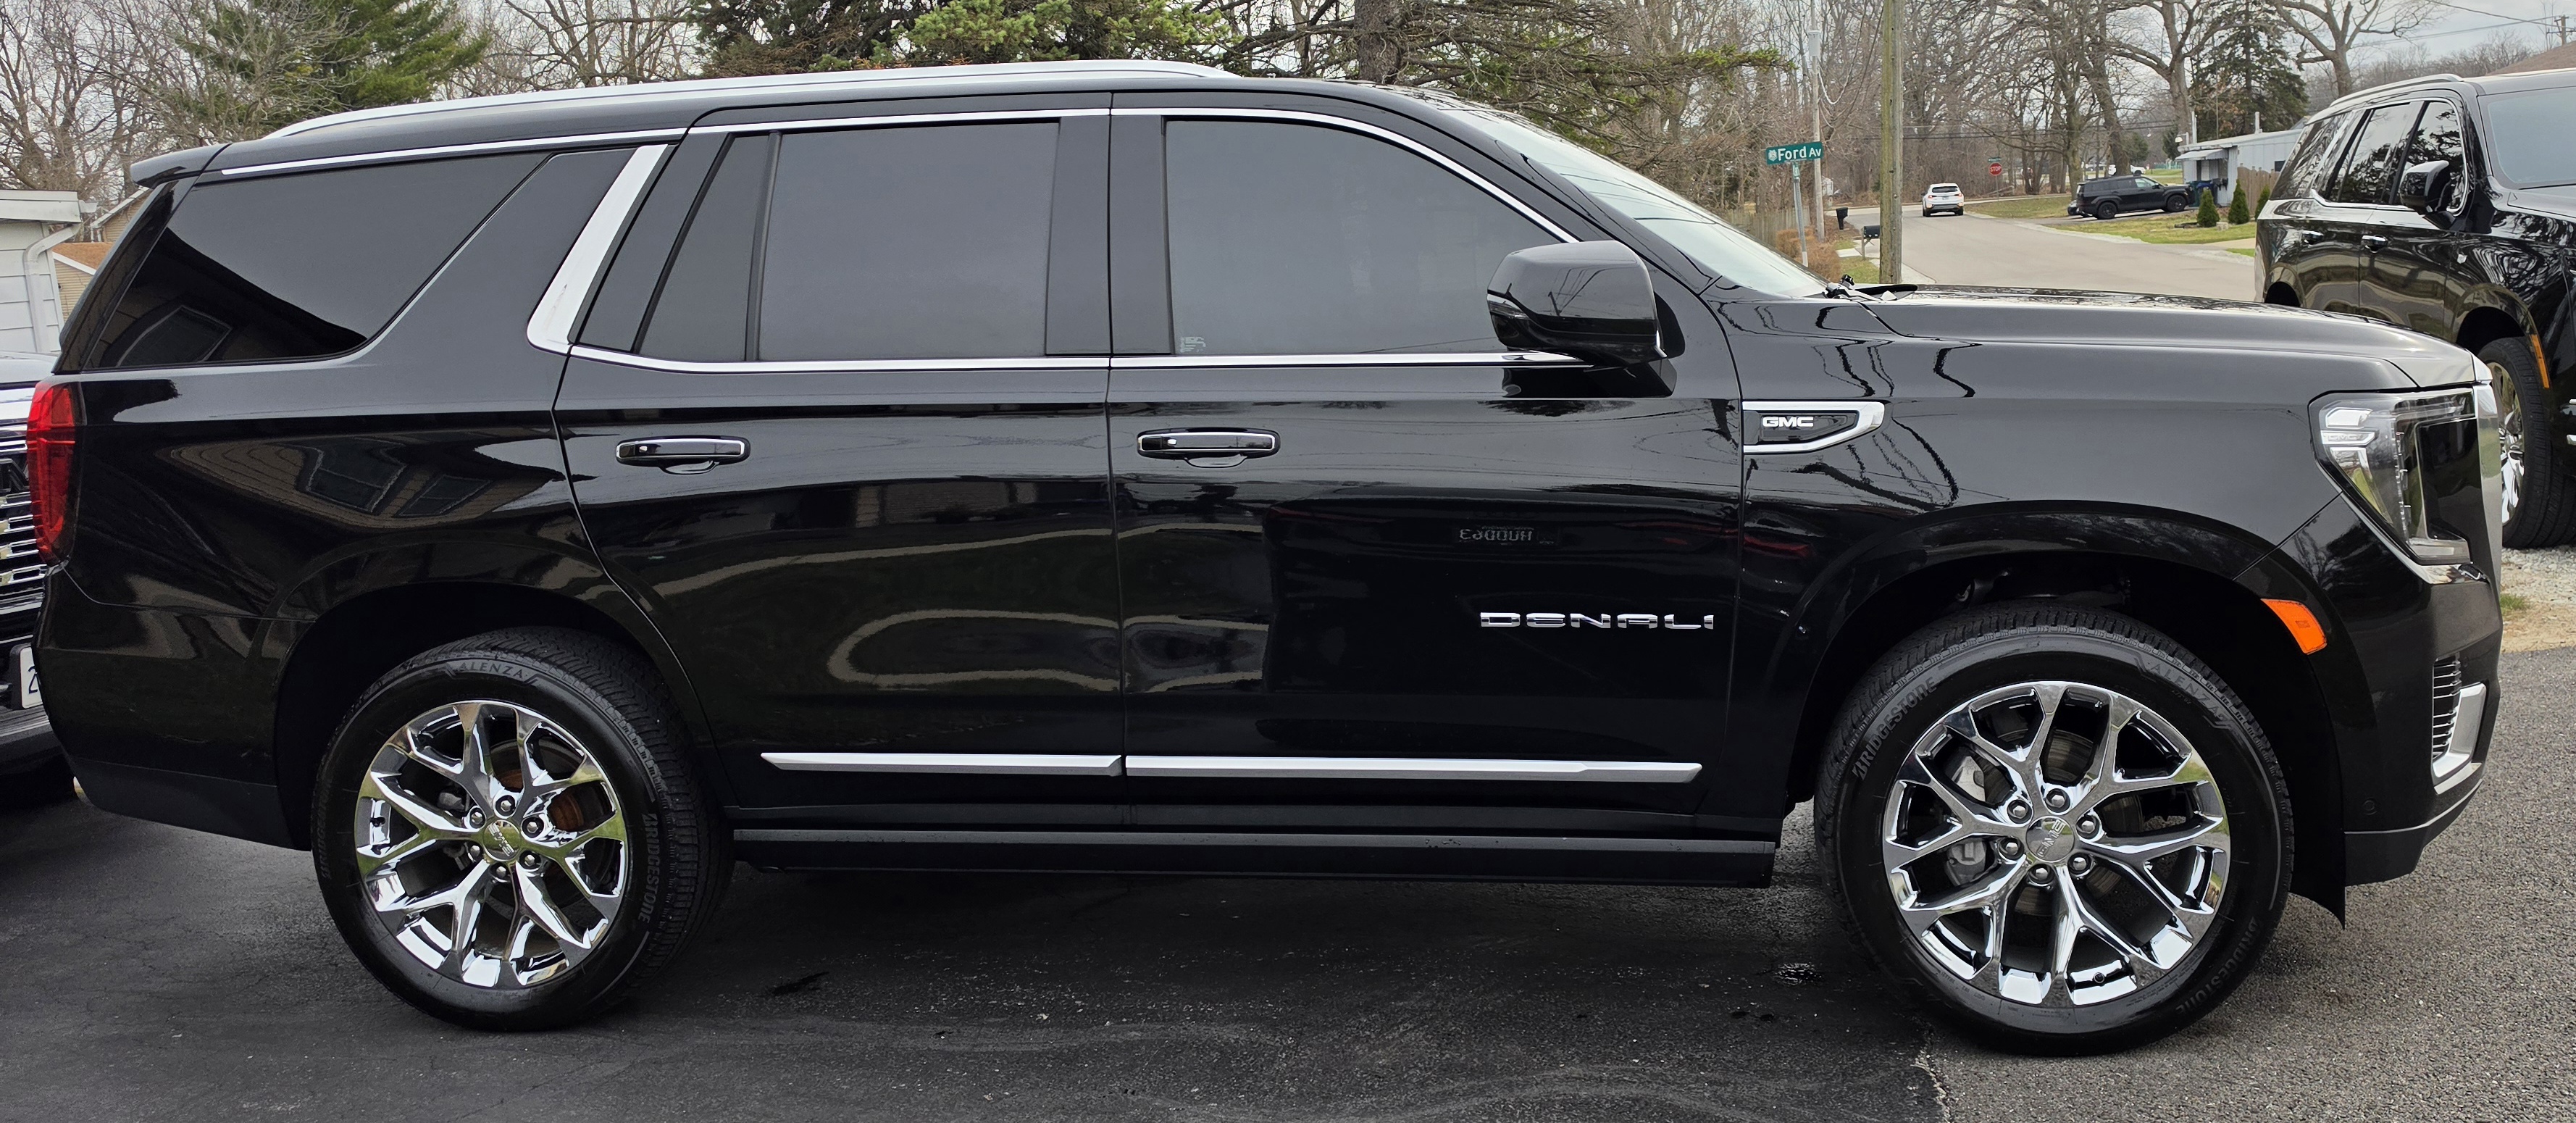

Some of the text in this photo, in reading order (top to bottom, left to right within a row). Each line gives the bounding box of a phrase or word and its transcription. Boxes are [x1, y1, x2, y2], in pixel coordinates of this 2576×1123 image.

[1778, 146, 1821, 161] Ford Av
[1762, 417, 1814, 427] GMC
[1480, 612, 1714, 630] DENALI
[458, 661, 524, 680] ALENZA
[2150, 663, 2220, 717] ALENZA
[1852, 677, 1938, 781] BRIDGESTONE
[2037, 819, 2067, 857] GMC
[637, 813, 661, 924] BRIDGESTONE
[2175, 916, 2259, 1014] BRIDGESTONE
